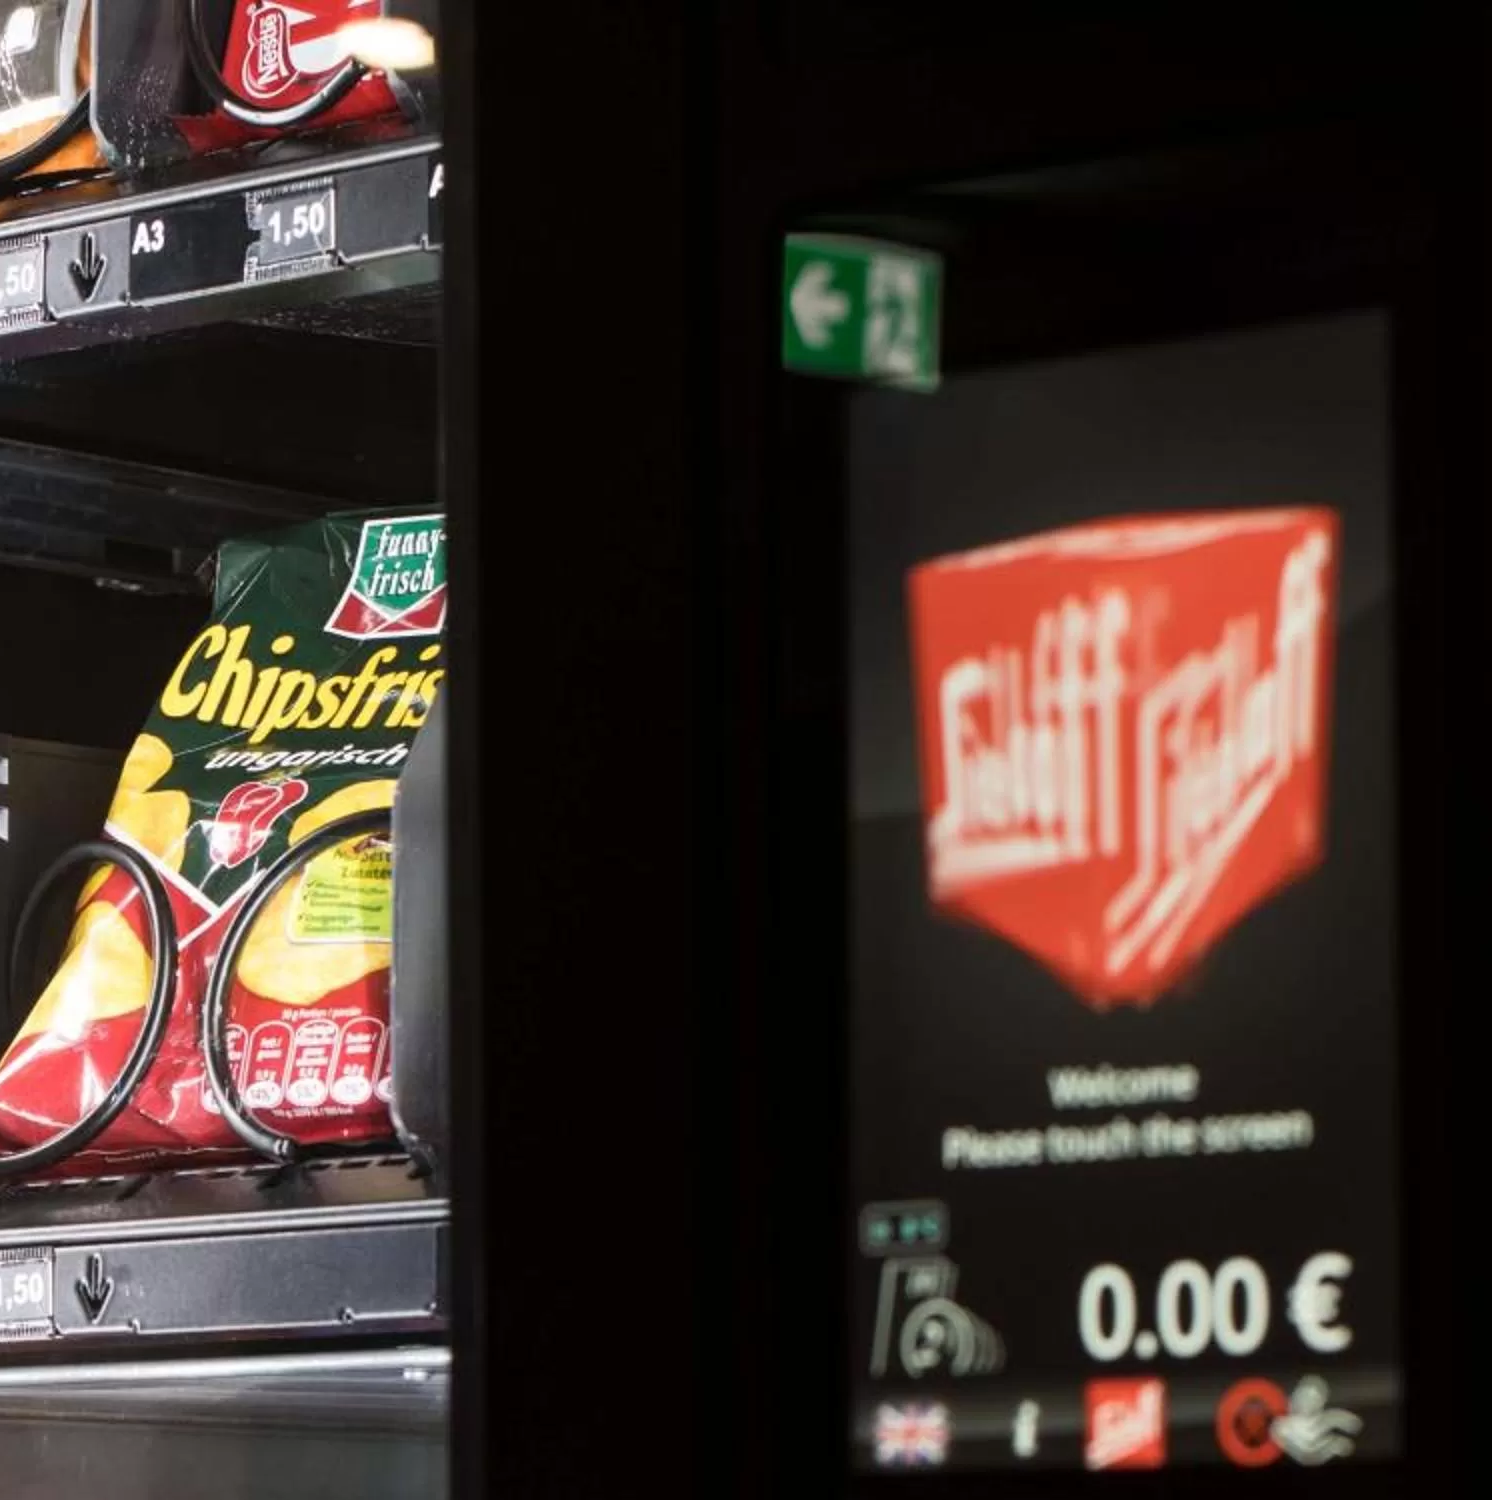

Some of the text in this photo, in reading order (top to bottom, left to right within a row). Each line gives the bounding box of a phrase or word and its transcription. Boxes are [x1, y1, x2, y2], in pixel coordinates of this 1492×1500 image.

[132, 205, 325, 254] A3 1,50
[368, 560, 434, 598] frisch
[204, 742, 408, 773] ungarisch
[1048, 1062, 1199, 1109] Welcome
[942, 1109, 1314, 1170] Please touch the screen
[1078, 1251, 1354, 1362] 0.00 €
